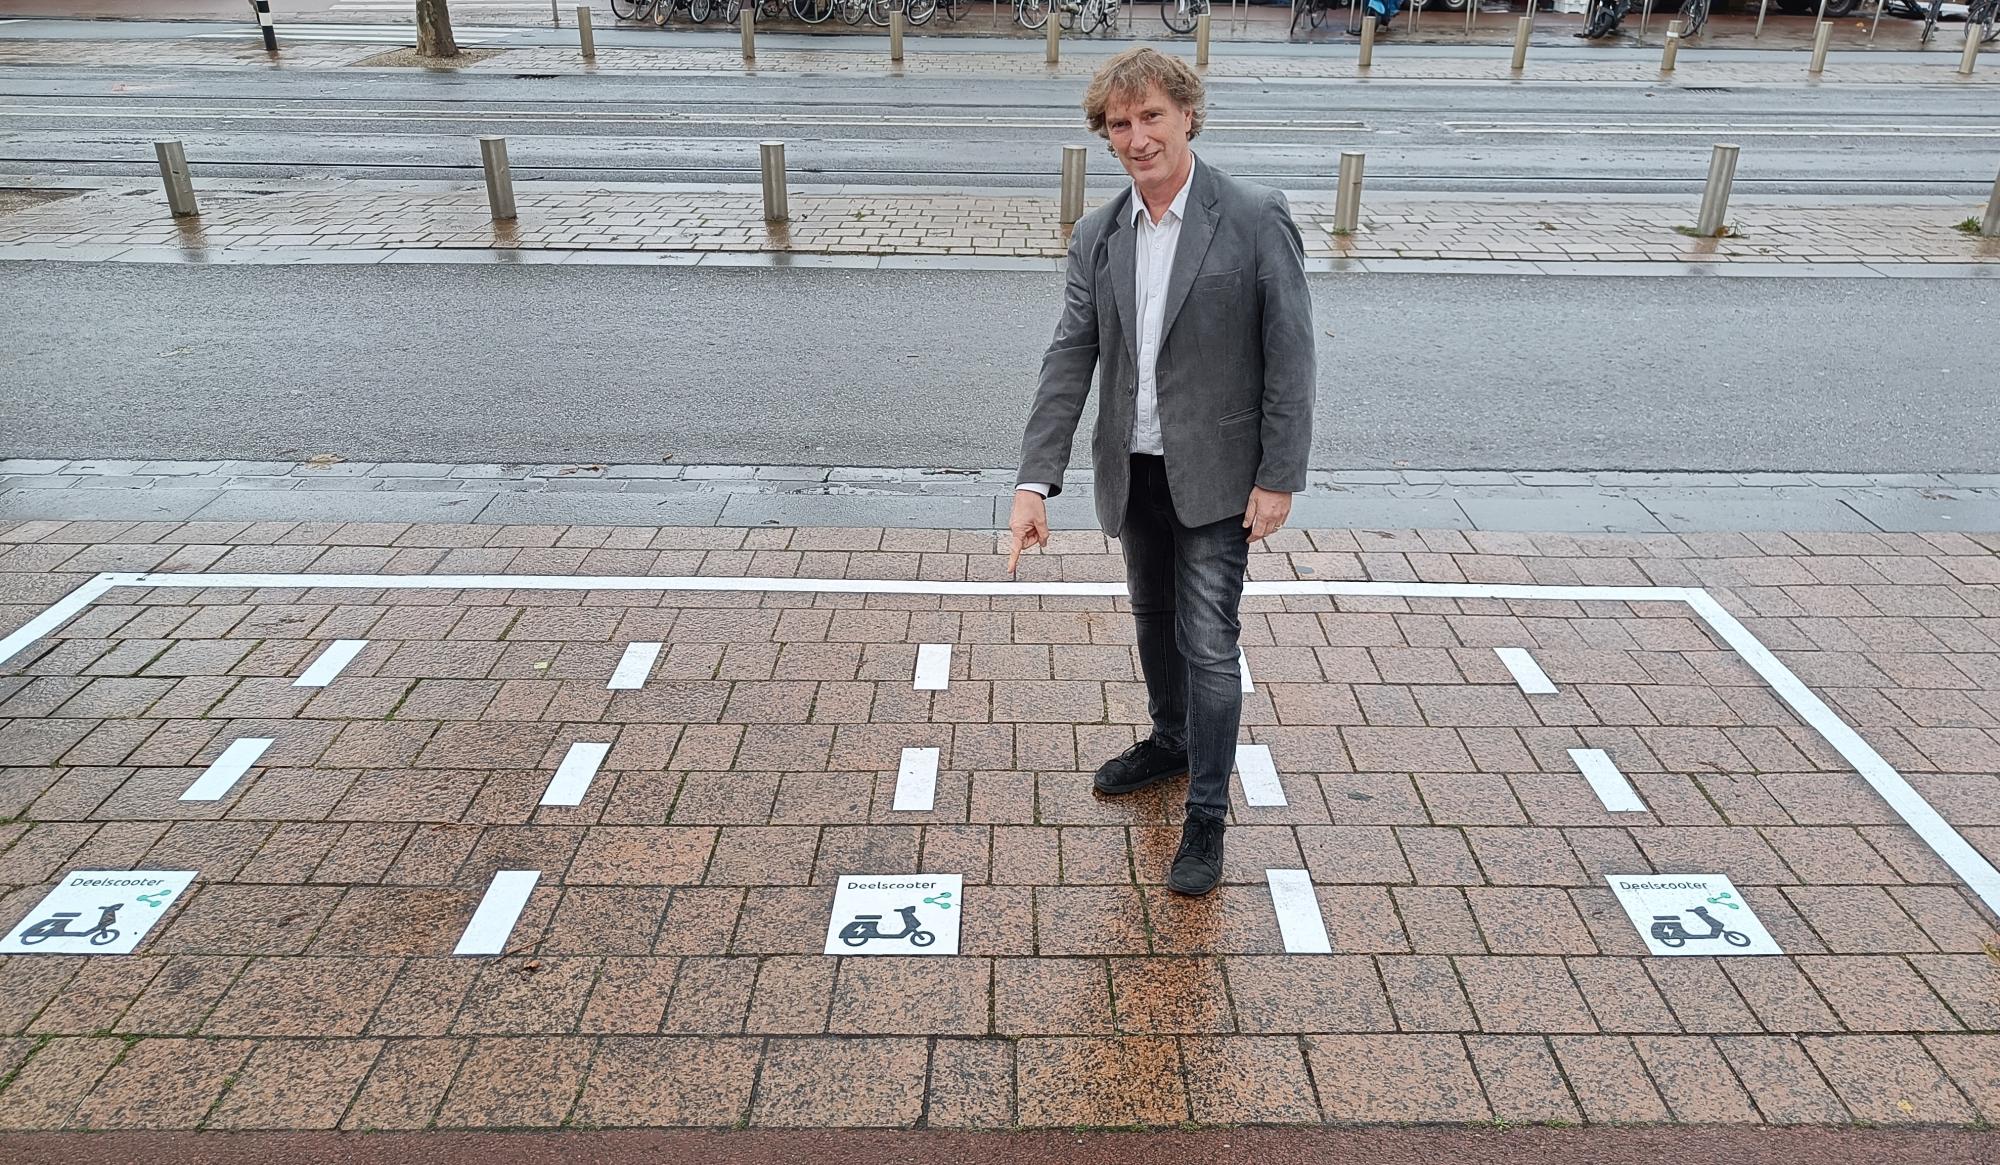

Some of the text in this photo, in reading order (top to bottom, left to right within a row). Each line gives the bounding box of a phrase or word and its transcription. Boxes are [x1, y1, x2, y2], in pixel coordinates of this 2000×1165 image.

[70, 877, 165, 887] Deelscooter
[847, 881, 937, 890] Deelscooter
[1619, 881, 1709, 890] Deelscooter
